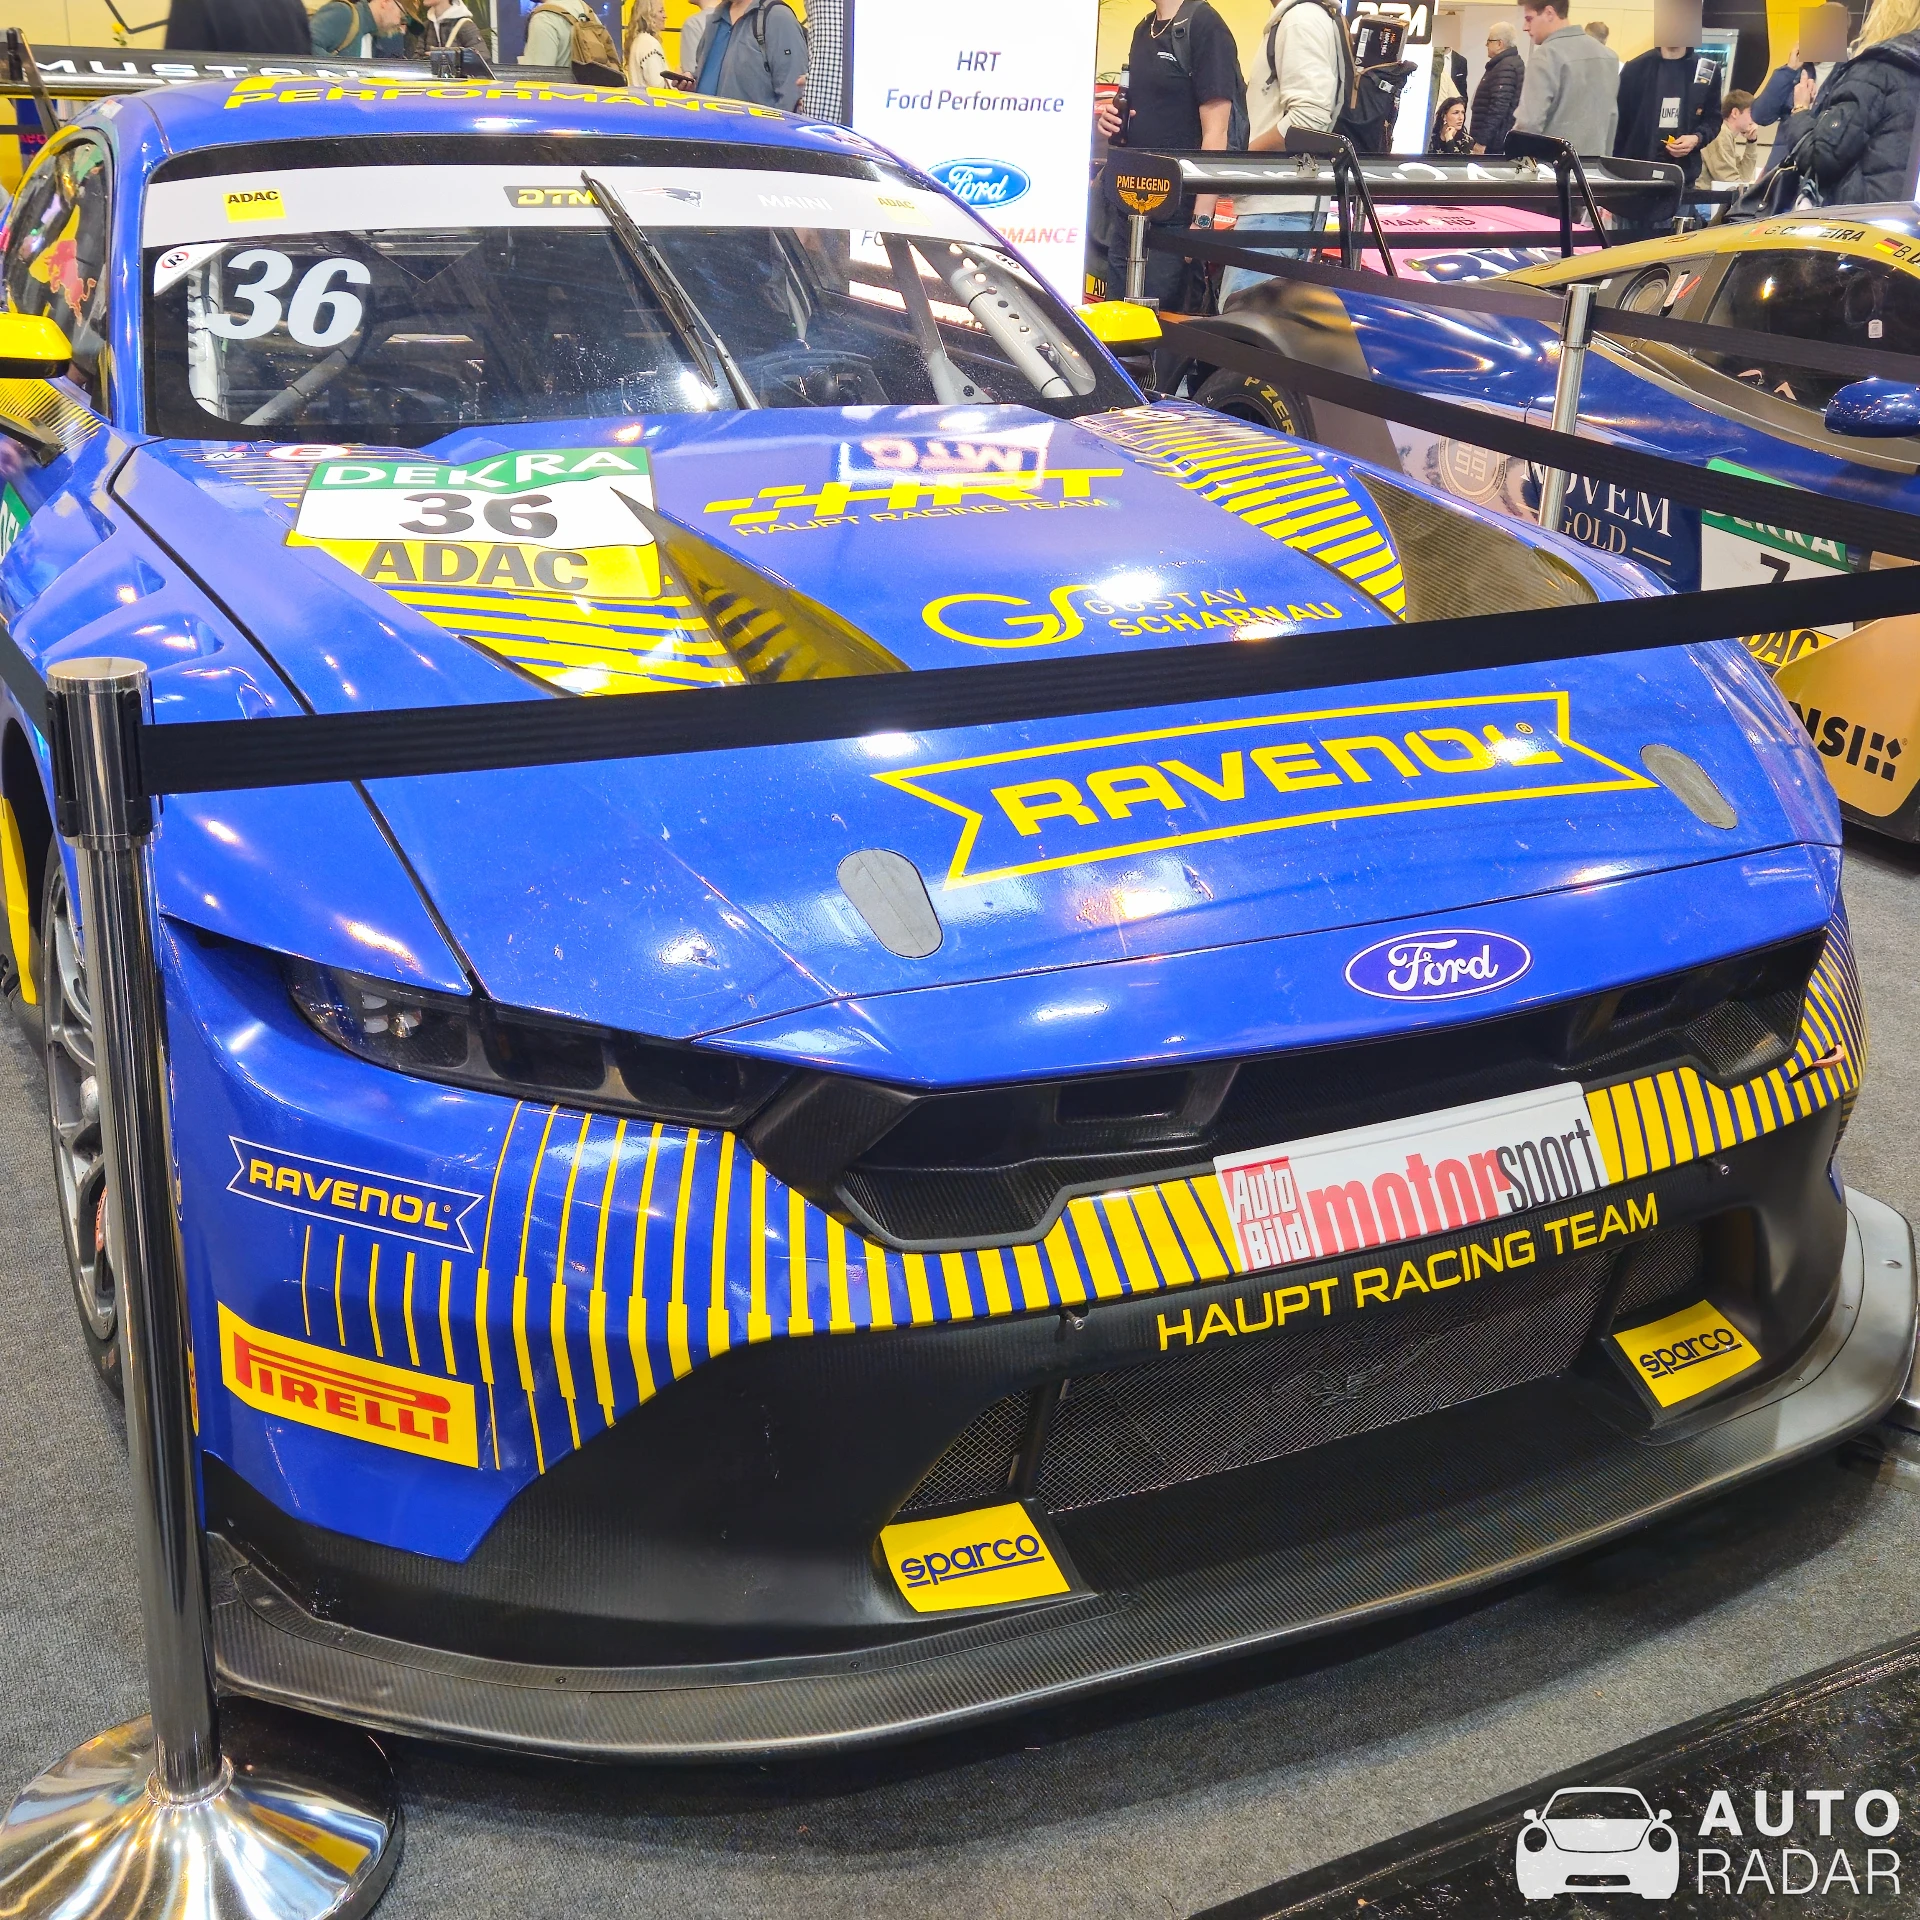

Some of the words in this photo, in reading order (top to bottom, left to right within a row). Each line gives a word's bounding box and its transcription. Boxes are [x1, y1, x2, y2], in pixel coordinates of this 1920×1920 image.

[957, 51, 1001, 72] HRT
[223, 86, 787, 121] PERFORMANCE
[885, 88, 933, 111] Ford
[938, 90, 1065, 113] Performance
[1662, 107, 1680, 119] UNFA
[227, 189, 278, 204] ADAC
[517, 189, 599, 205] DTM
[757, 194, 834, 211] MAINI
[943, 165, 1010, 202] Ford
[1117, 175, 1135, 189] PME
[1136, 177, 1171, 192] LEGEND
[878, 196, 916, 210] ADAC
[206, 248, 371, 348] 36
[321, 451, 639, 489] DEKRA
[805, 467, 1125, 518] HRT
[398, 492, 559, 539] 36
[734, 514, 861, 537] HAUPT
[868, 503, 1009, 524] RACING
[1009, 498, 1110, 513] TEAM
[360, 540, 590, 591] ADAC
[1108, 602, 1343, 637] SCHARNAU
[1741, 630, 1819, 665] DAC
[1387, 938, 1499, 992] Ford
[1231, 1163, 1298, 1224] Auto
[1242, 1211, 1313, 1270] Bild
[1156, 1278, 1339, 1352] HAUPT
[1353, 1230, 1540, 1310] RACING
[1544, 1193, 1660, 1256] TEAM
[1639, 1328, 1738, 1377] sparco
[233, 1330, 452, 1446] PIRELLI
[900, 1533, 1042, 1587] sparco
